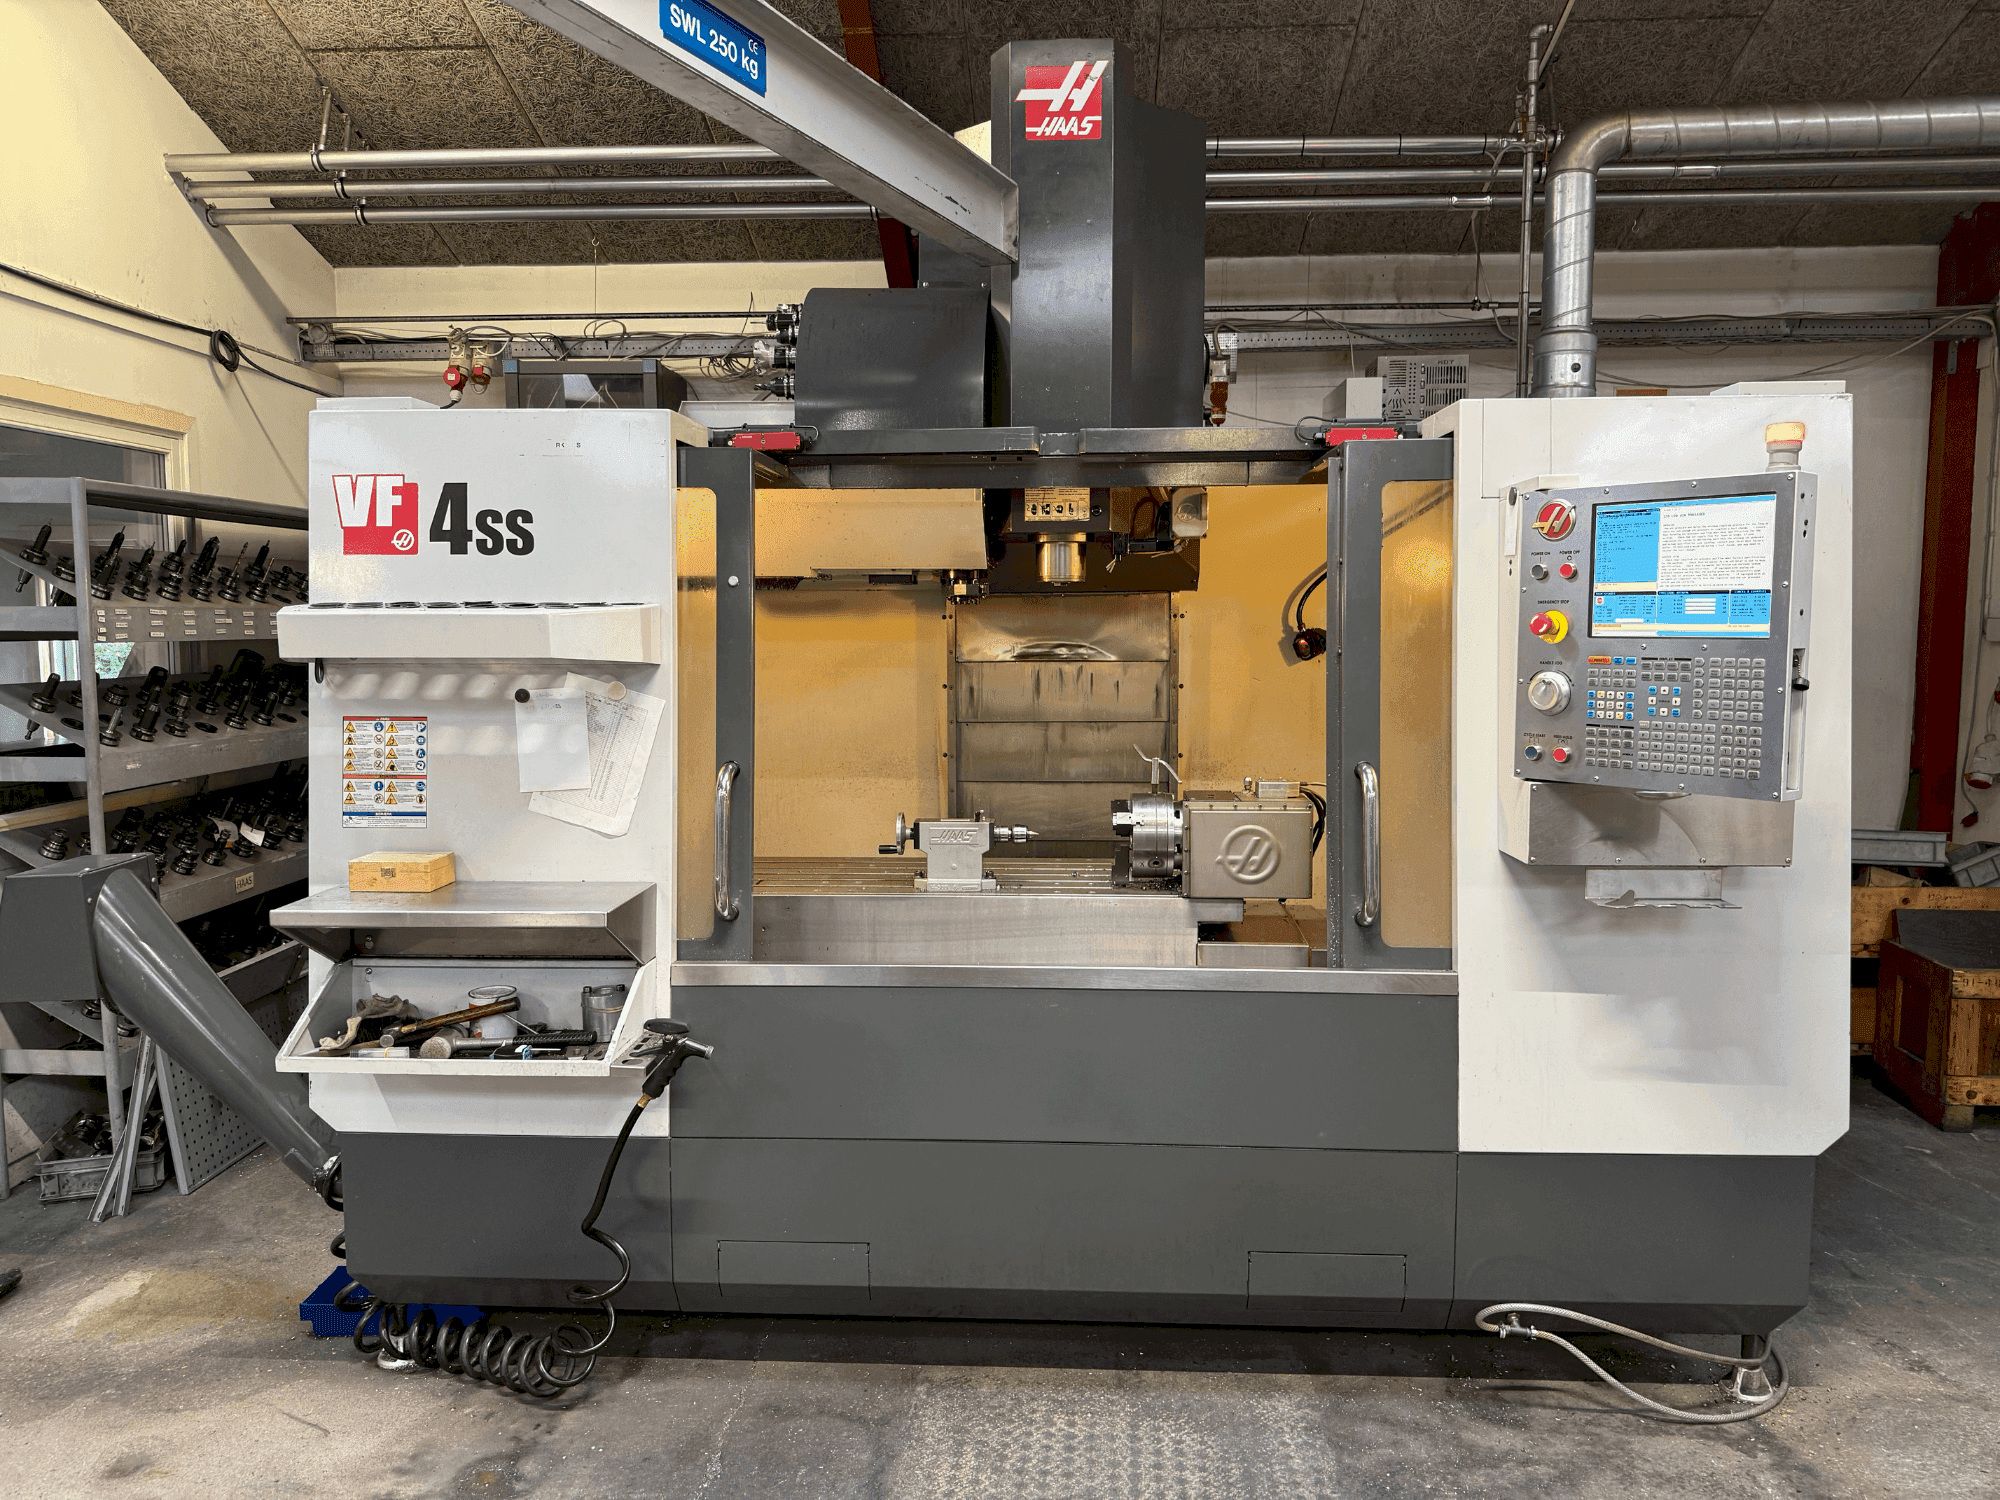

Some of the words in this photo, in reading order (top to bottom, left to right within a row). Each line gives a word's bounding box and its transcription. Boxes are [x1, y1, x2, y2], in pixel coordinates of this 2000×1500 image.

[670, 4, 706, 44] SWL
[709, 29, 737, 63] 250
[741, 48, 758, 80] kg
[1026, 116, 1102, 136] HAAS
[333, 475, 404, 527] VF
[931, 830, 978, 842] HAAS
[236, 876, 252, 888] HAAS
